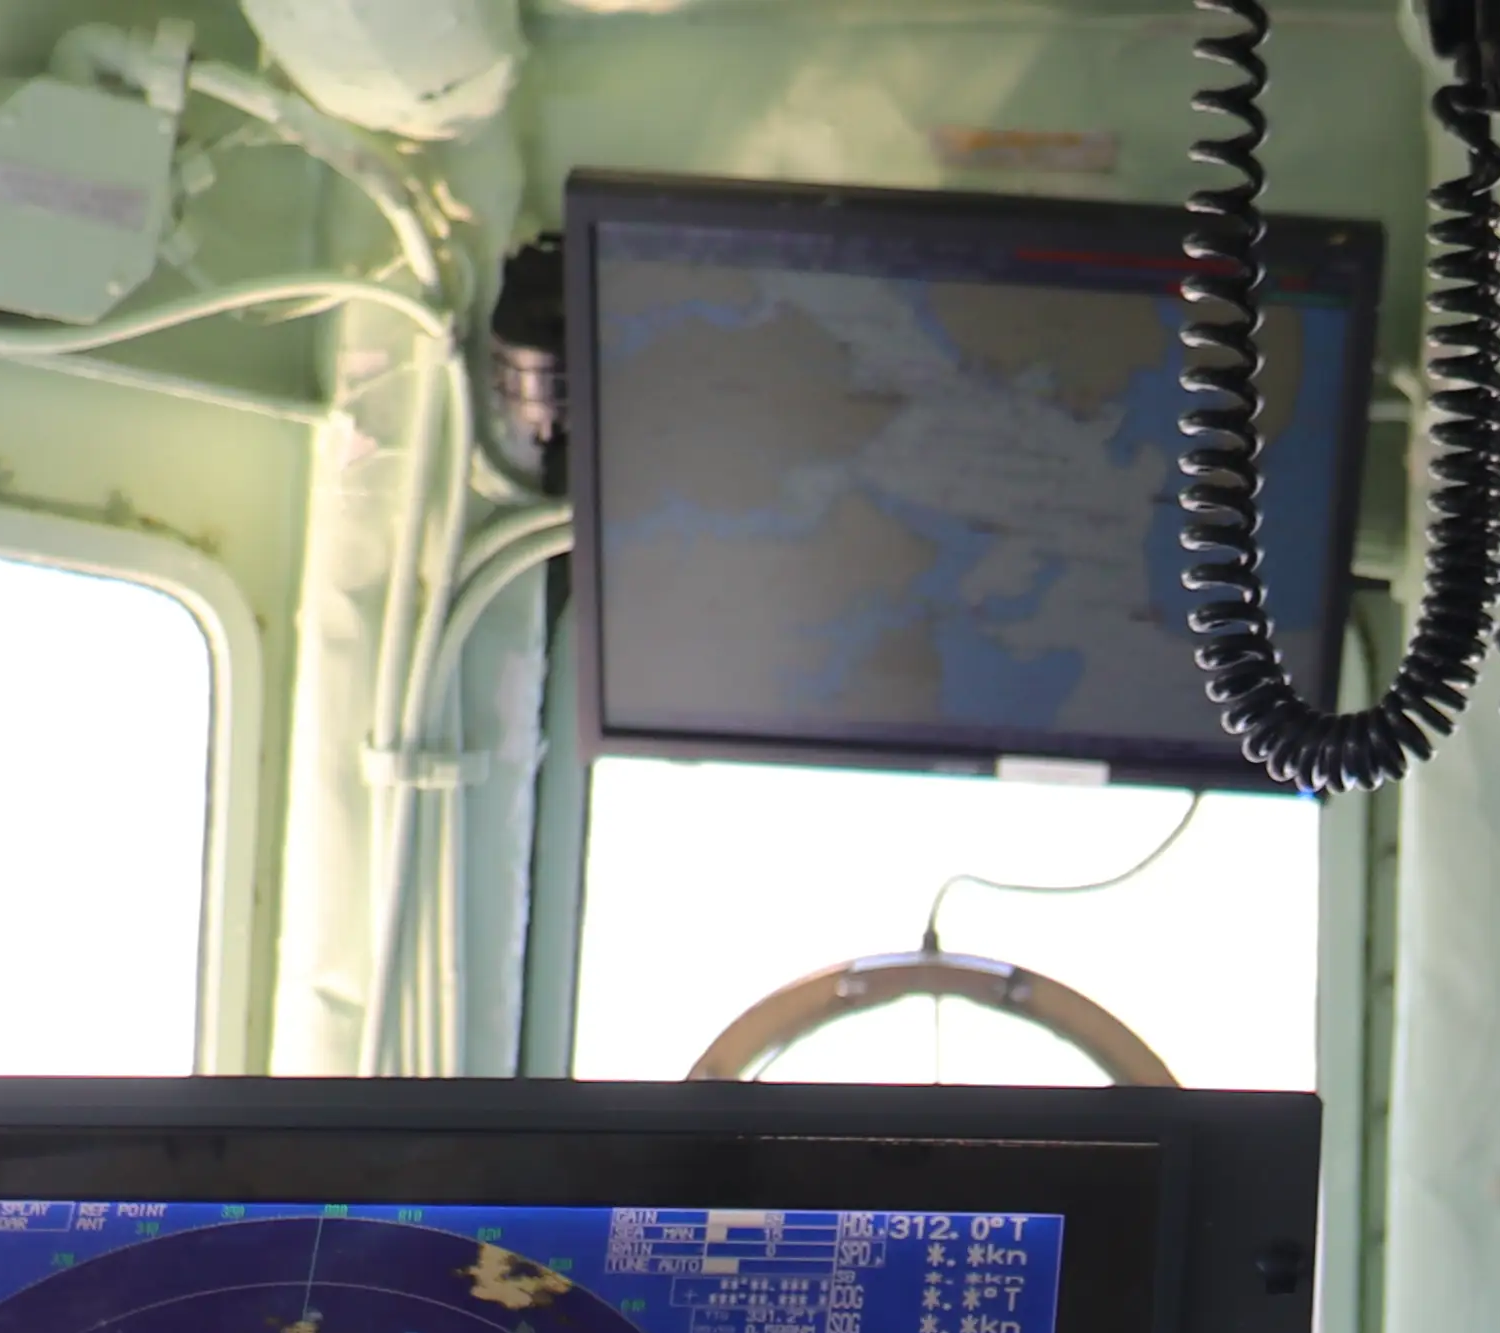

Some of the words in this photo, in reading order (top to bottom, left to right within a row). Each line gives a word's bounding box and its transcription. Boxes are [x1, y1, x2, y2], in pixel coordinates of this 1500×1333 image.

[78, 1203, 111, 1216] REF
[117, 1203, 168, 1217] POINT
[76, 1218, 107, 1230] ANT
[841, 1214, 874, 1238] HDG
[613, 1226, 645, 1240] SEA
[839, 1242, 871, 1264] SPD
[608, 1259, 649, 1272] TUNE
[658, 1259, 700, 1273] AUTO
[832, 1285, 864, 1309] COG
